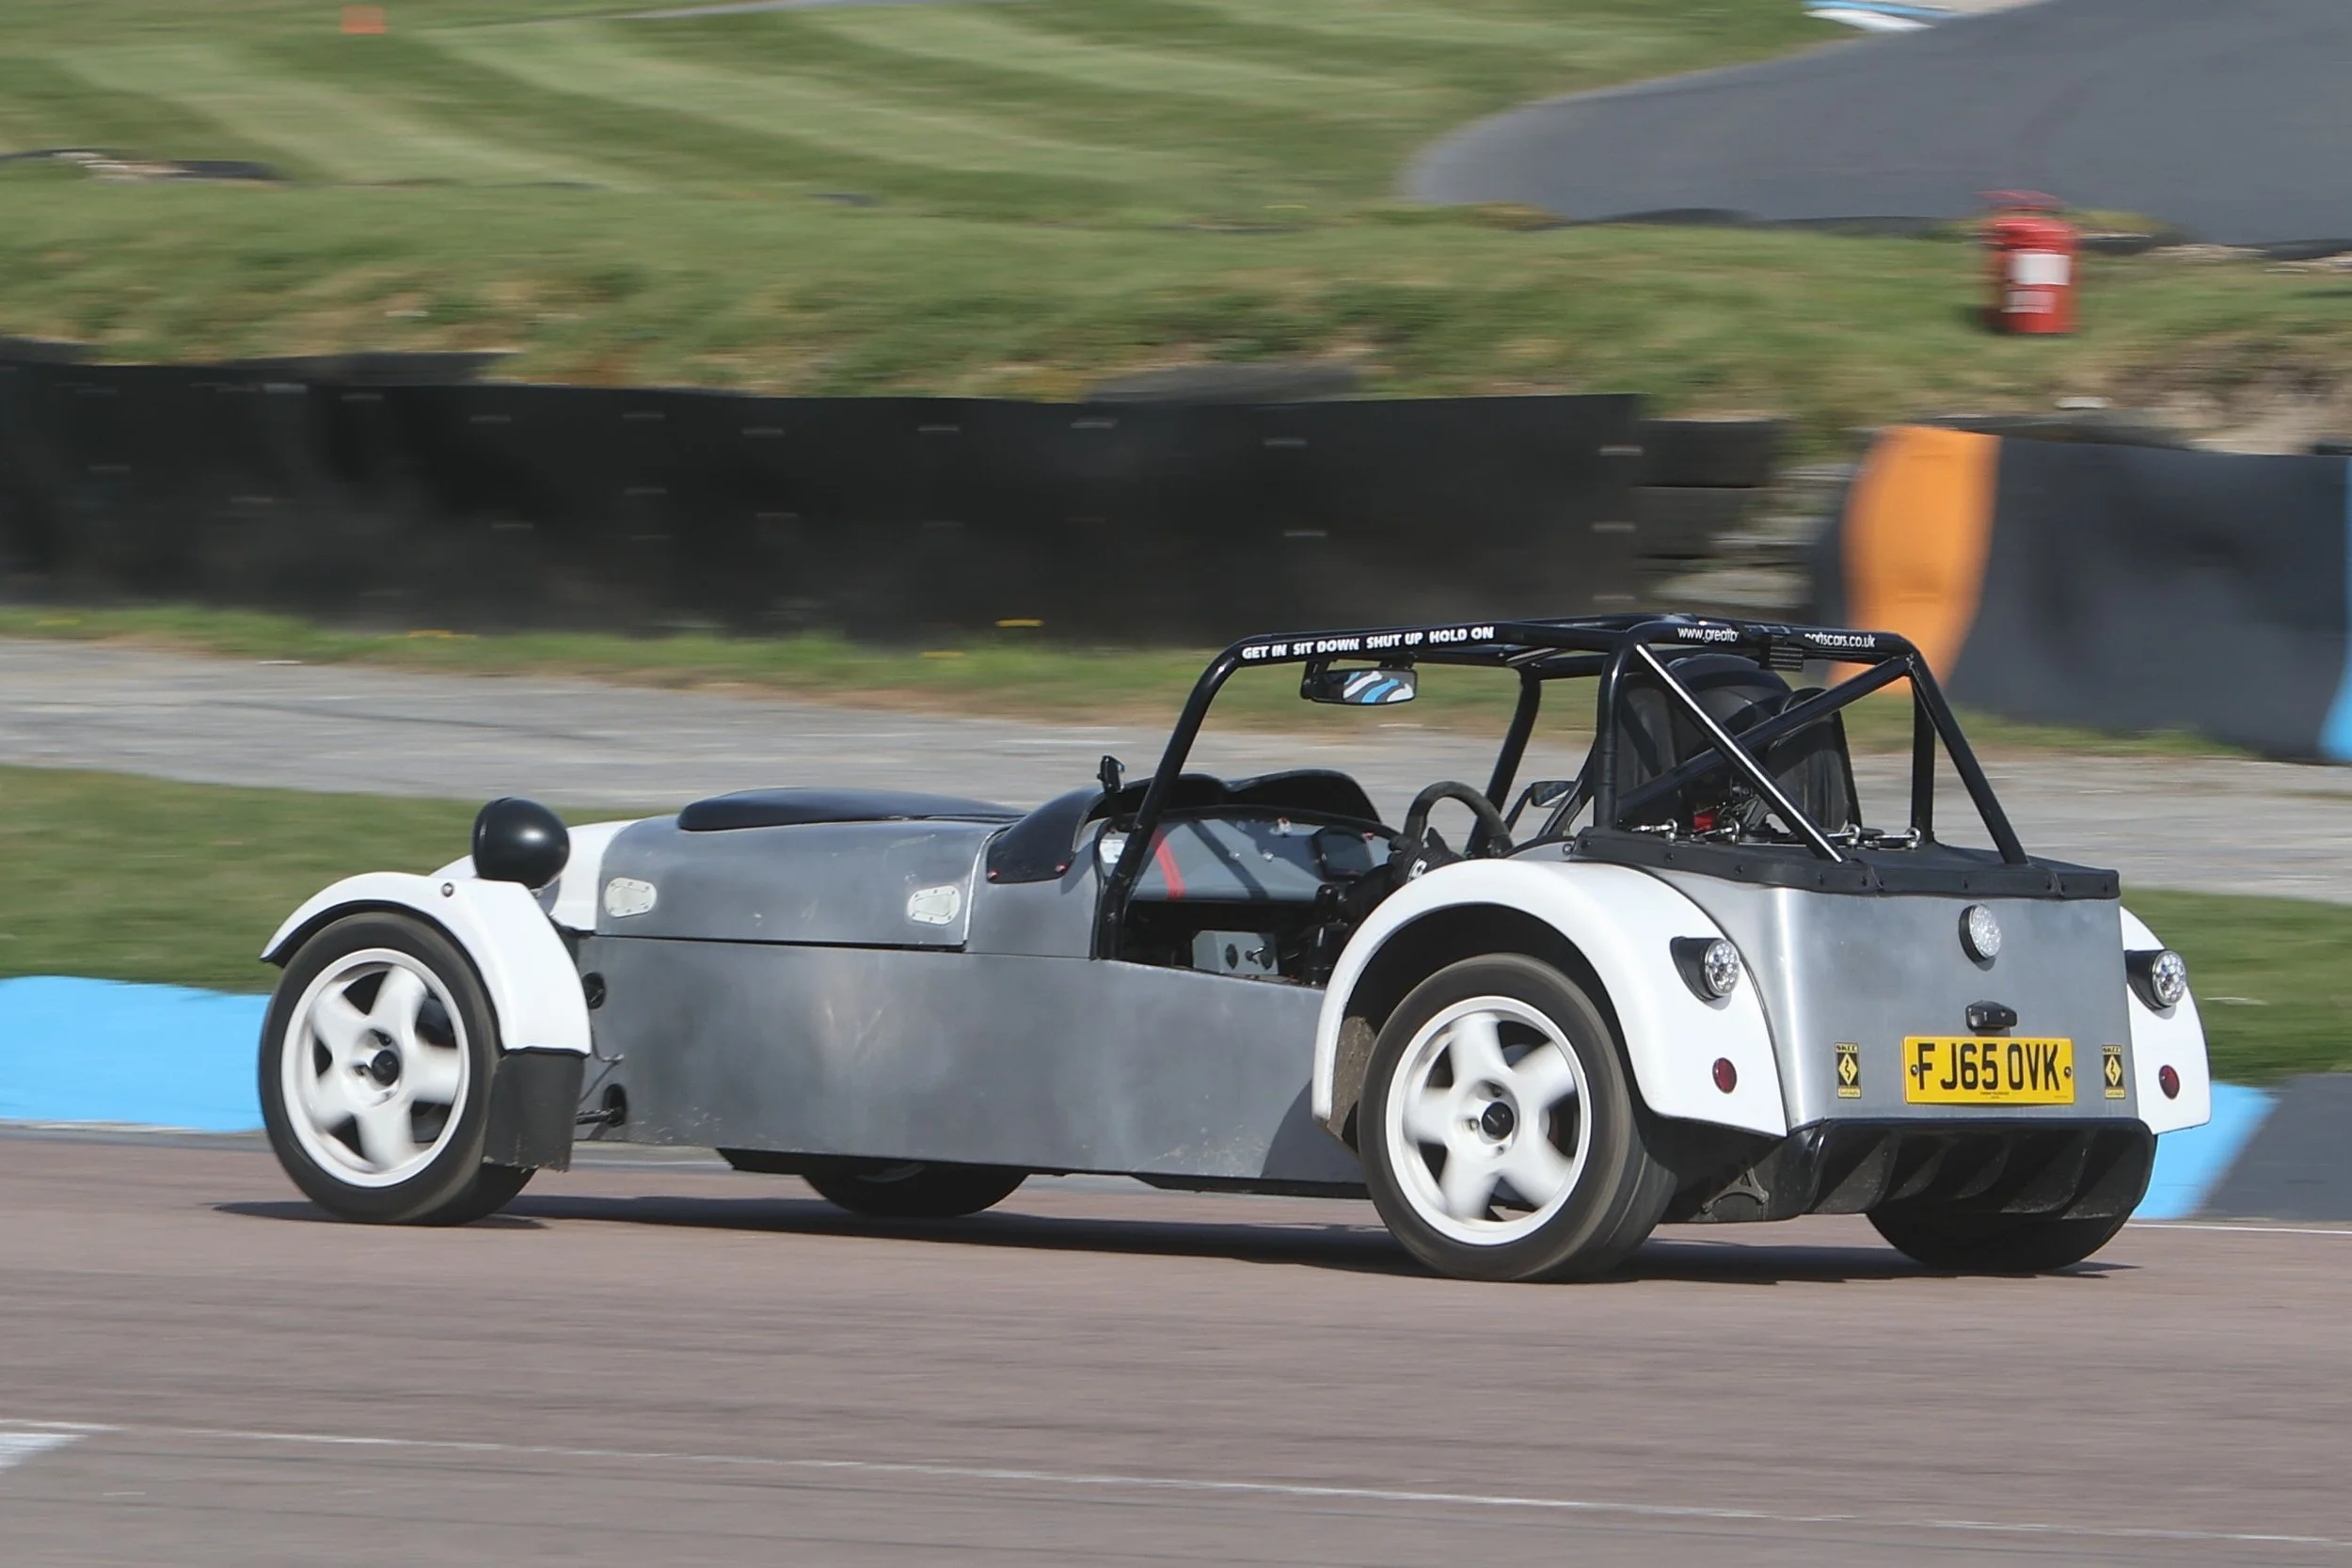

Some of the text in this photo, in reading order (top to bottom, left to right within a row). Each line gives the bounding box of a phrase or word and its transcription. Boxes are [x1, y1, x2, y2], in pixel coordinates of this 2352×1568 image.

[1242, 626, 1494, 659] GET IN SIT DOWN SHUT UP HOLD ON
[1916, 1042, 2060, 1091] FJ65 OVK
